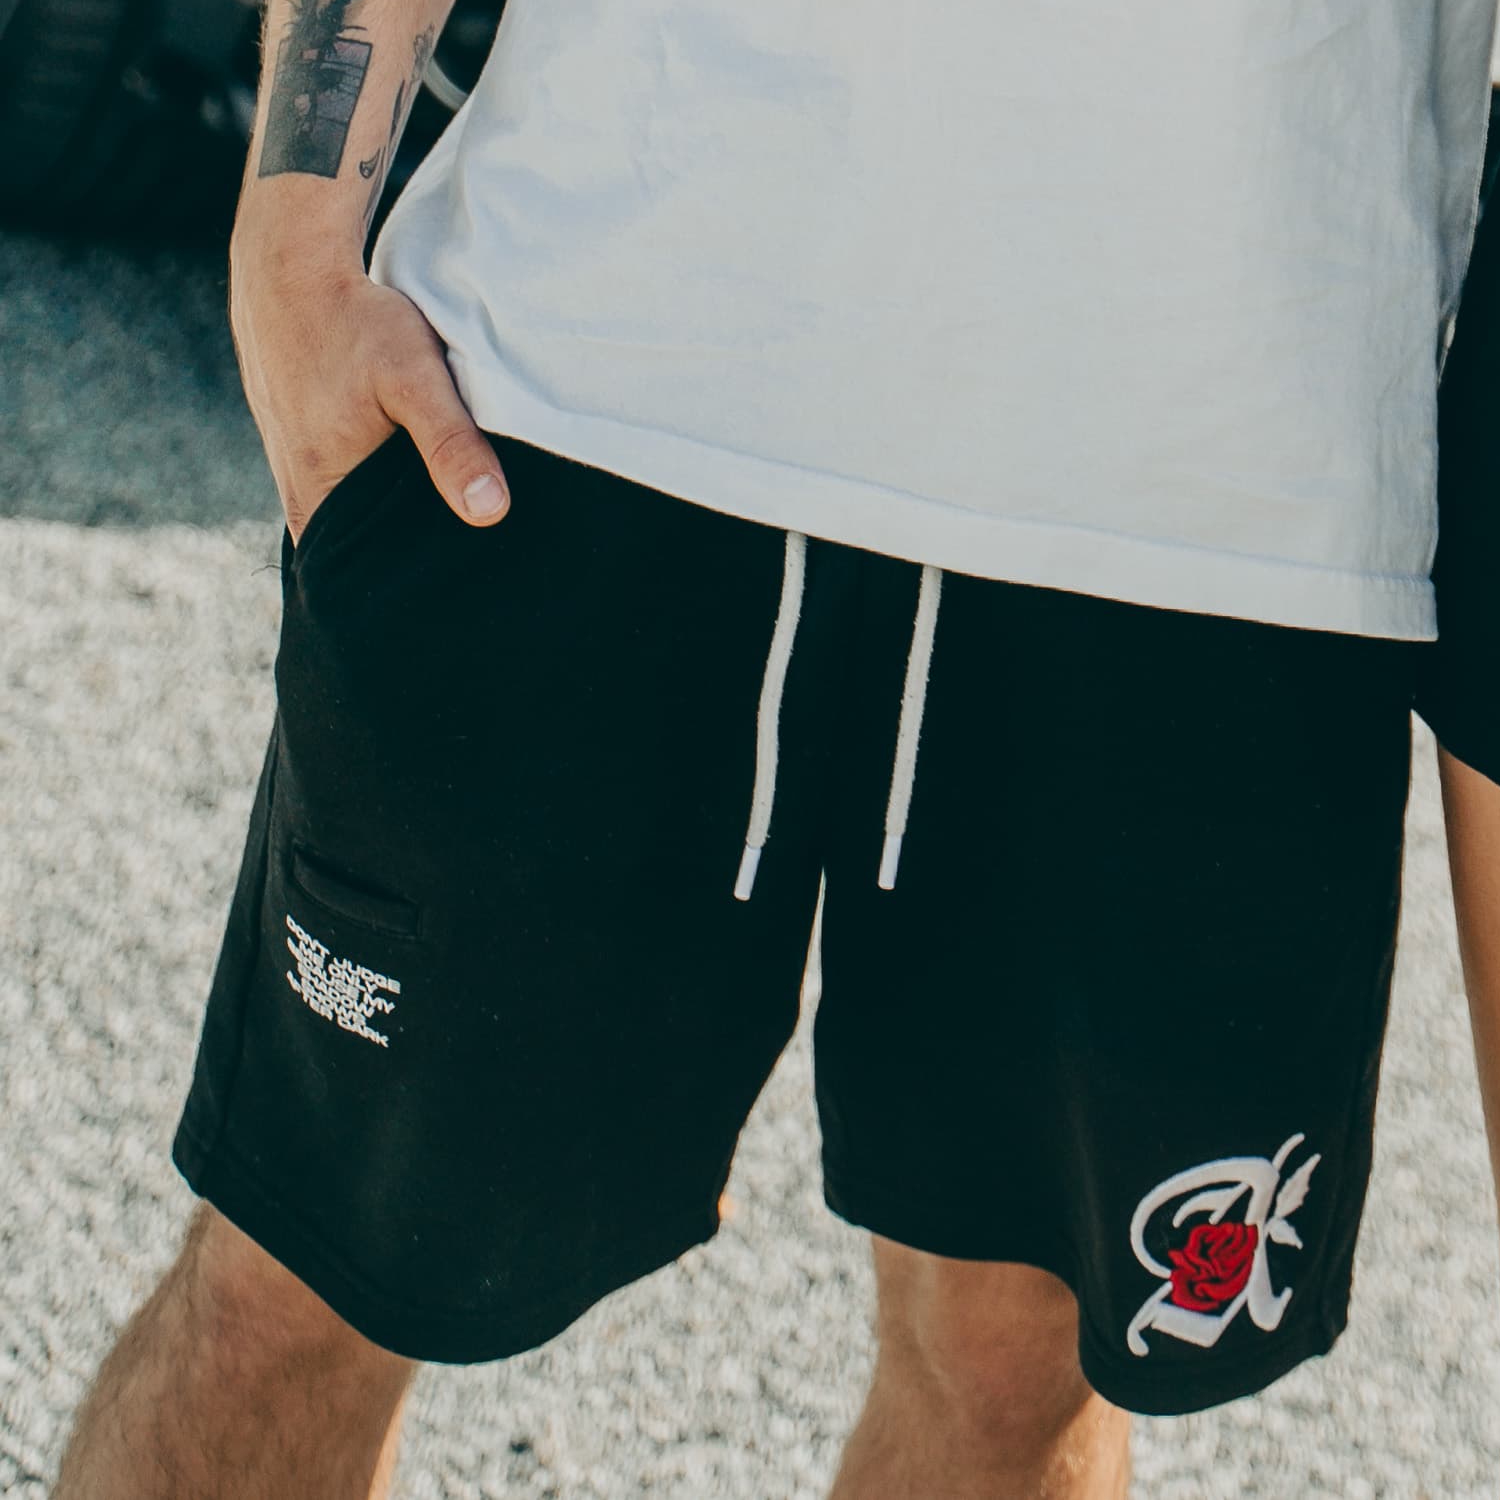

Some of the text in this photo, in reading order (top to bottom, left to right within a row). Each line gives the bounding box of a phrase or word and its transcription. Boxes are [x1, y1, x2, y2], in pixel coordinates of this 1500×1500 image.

[328, 962, 378, 994] ONLY
[333, 957, 401, 994] JUDGE
[363, 993, 396, 1014] MY
[337, 1016, 389, 1048] DARK
